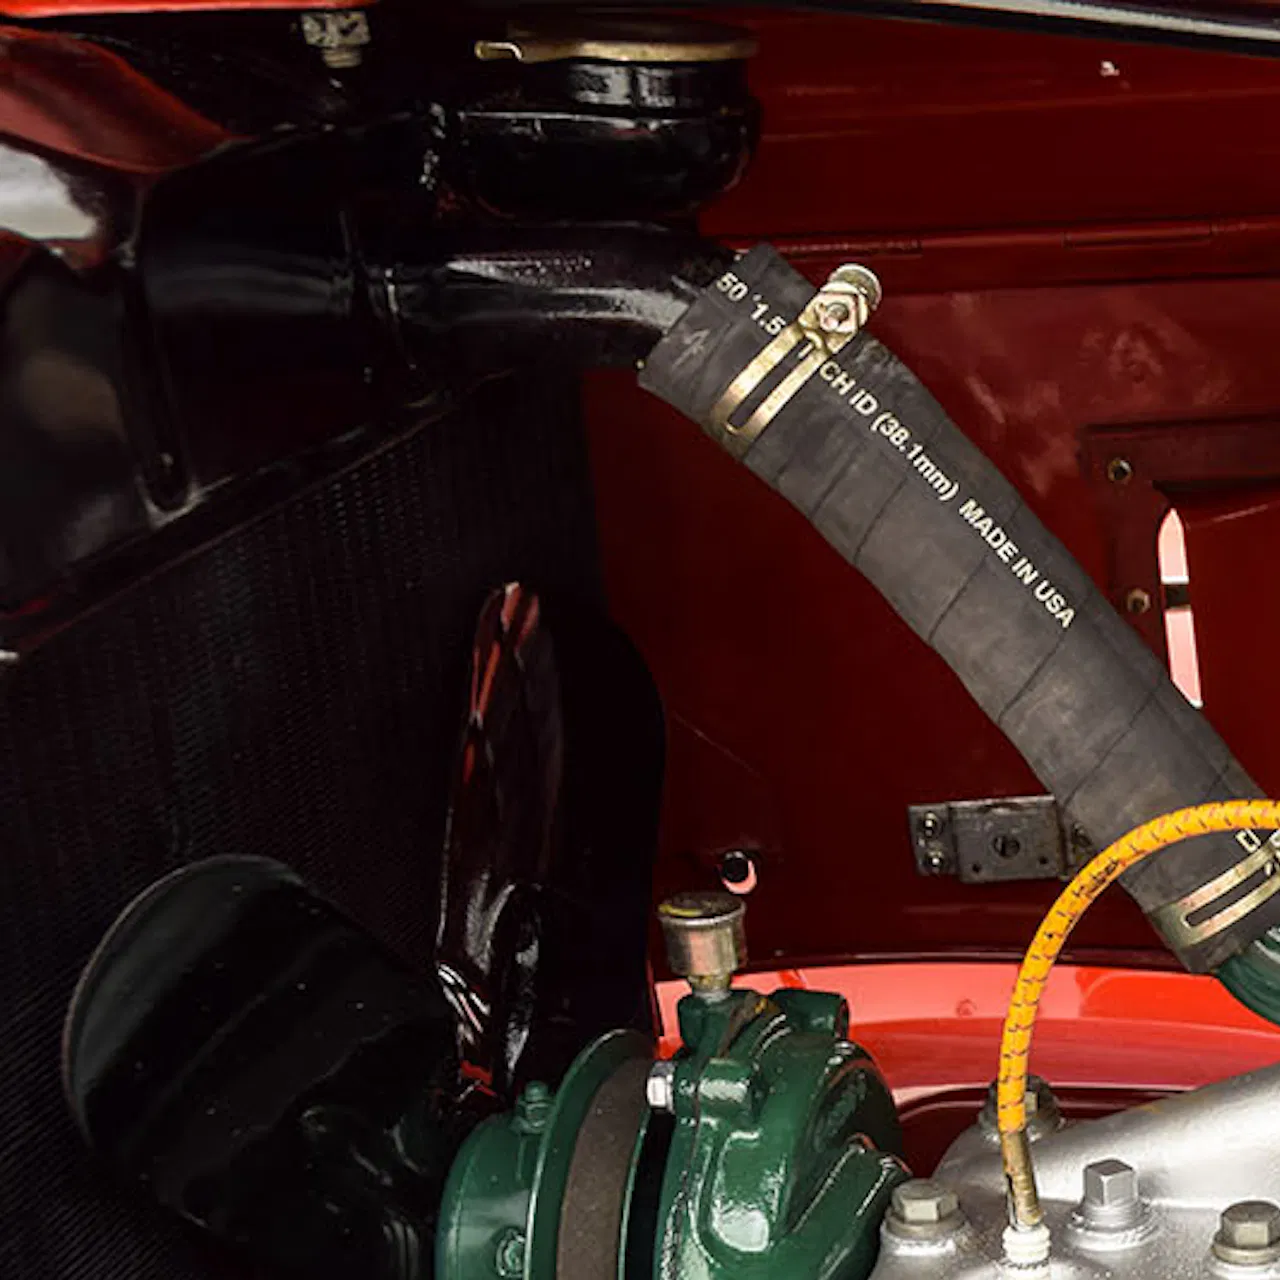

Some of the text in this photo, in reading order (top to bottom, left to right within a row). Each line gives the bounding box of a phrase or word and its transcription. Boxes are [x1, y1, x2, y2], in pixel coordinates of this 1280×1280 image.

[716, 271, 749, 302] 50
[848, 388, 879, 417] ID
[869, 410, 961, 502] (38.1mm)
[957, 498, 1019, 564] MADE
[1011, 556, 1047, 587] IN
[1040, 579, 1083, 629] USA
